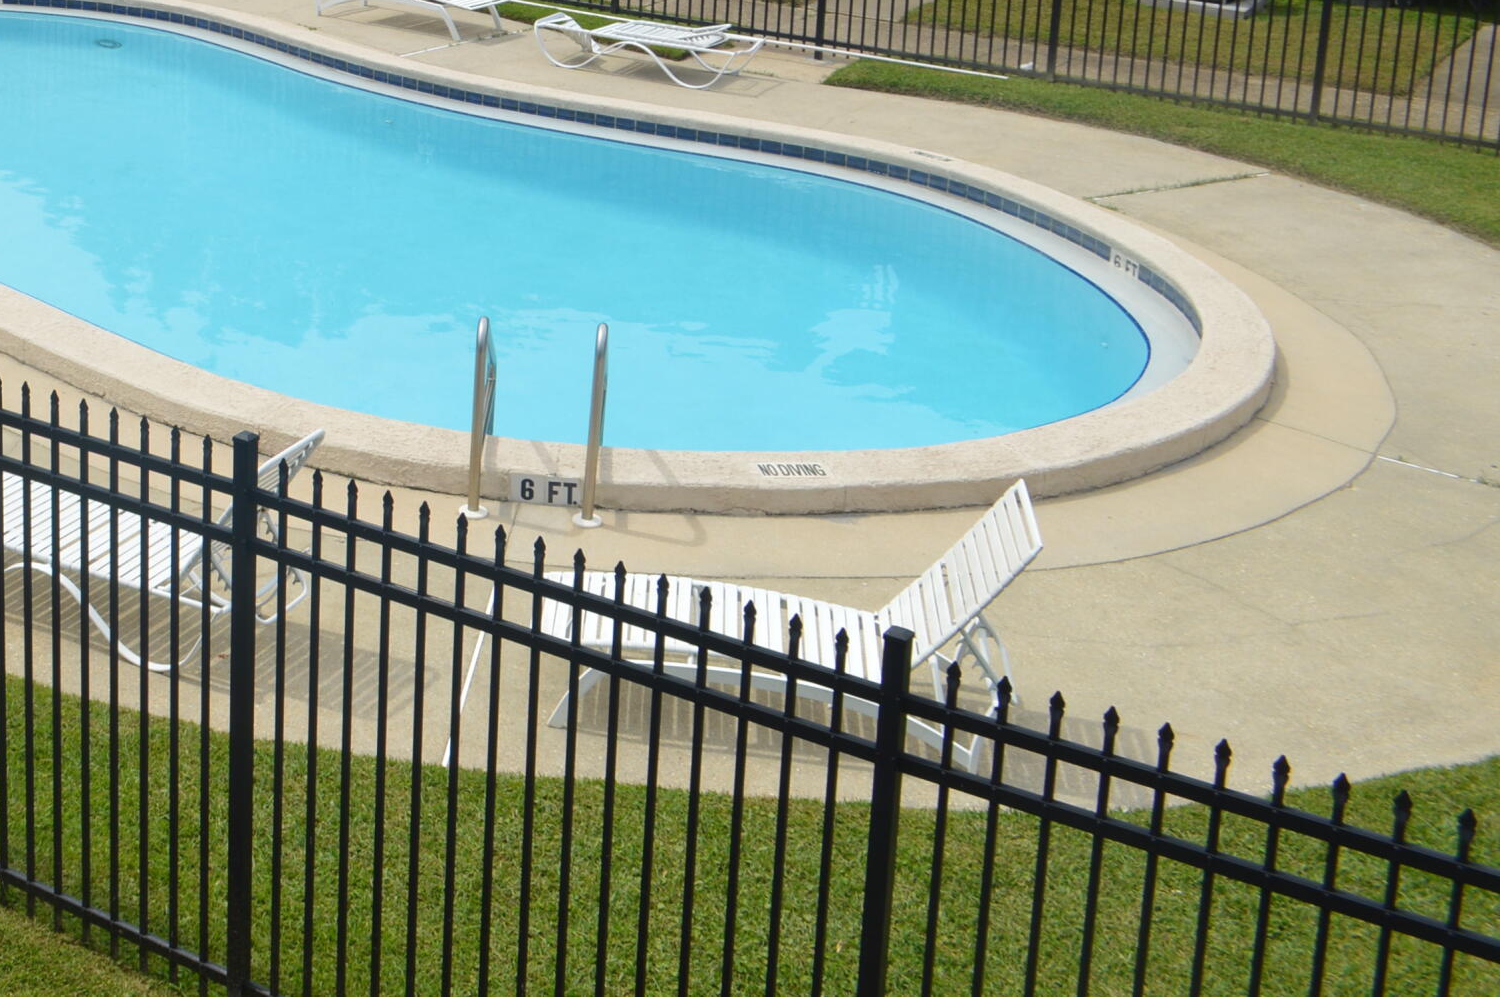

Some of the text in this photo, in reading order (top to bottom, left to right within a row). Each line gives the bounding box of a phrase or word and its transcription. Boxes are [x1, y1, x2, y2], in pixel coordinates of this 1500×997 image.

[757, 463, 827, 477] NO DIVING
[520, 478, 578, 505] 6 FT.
